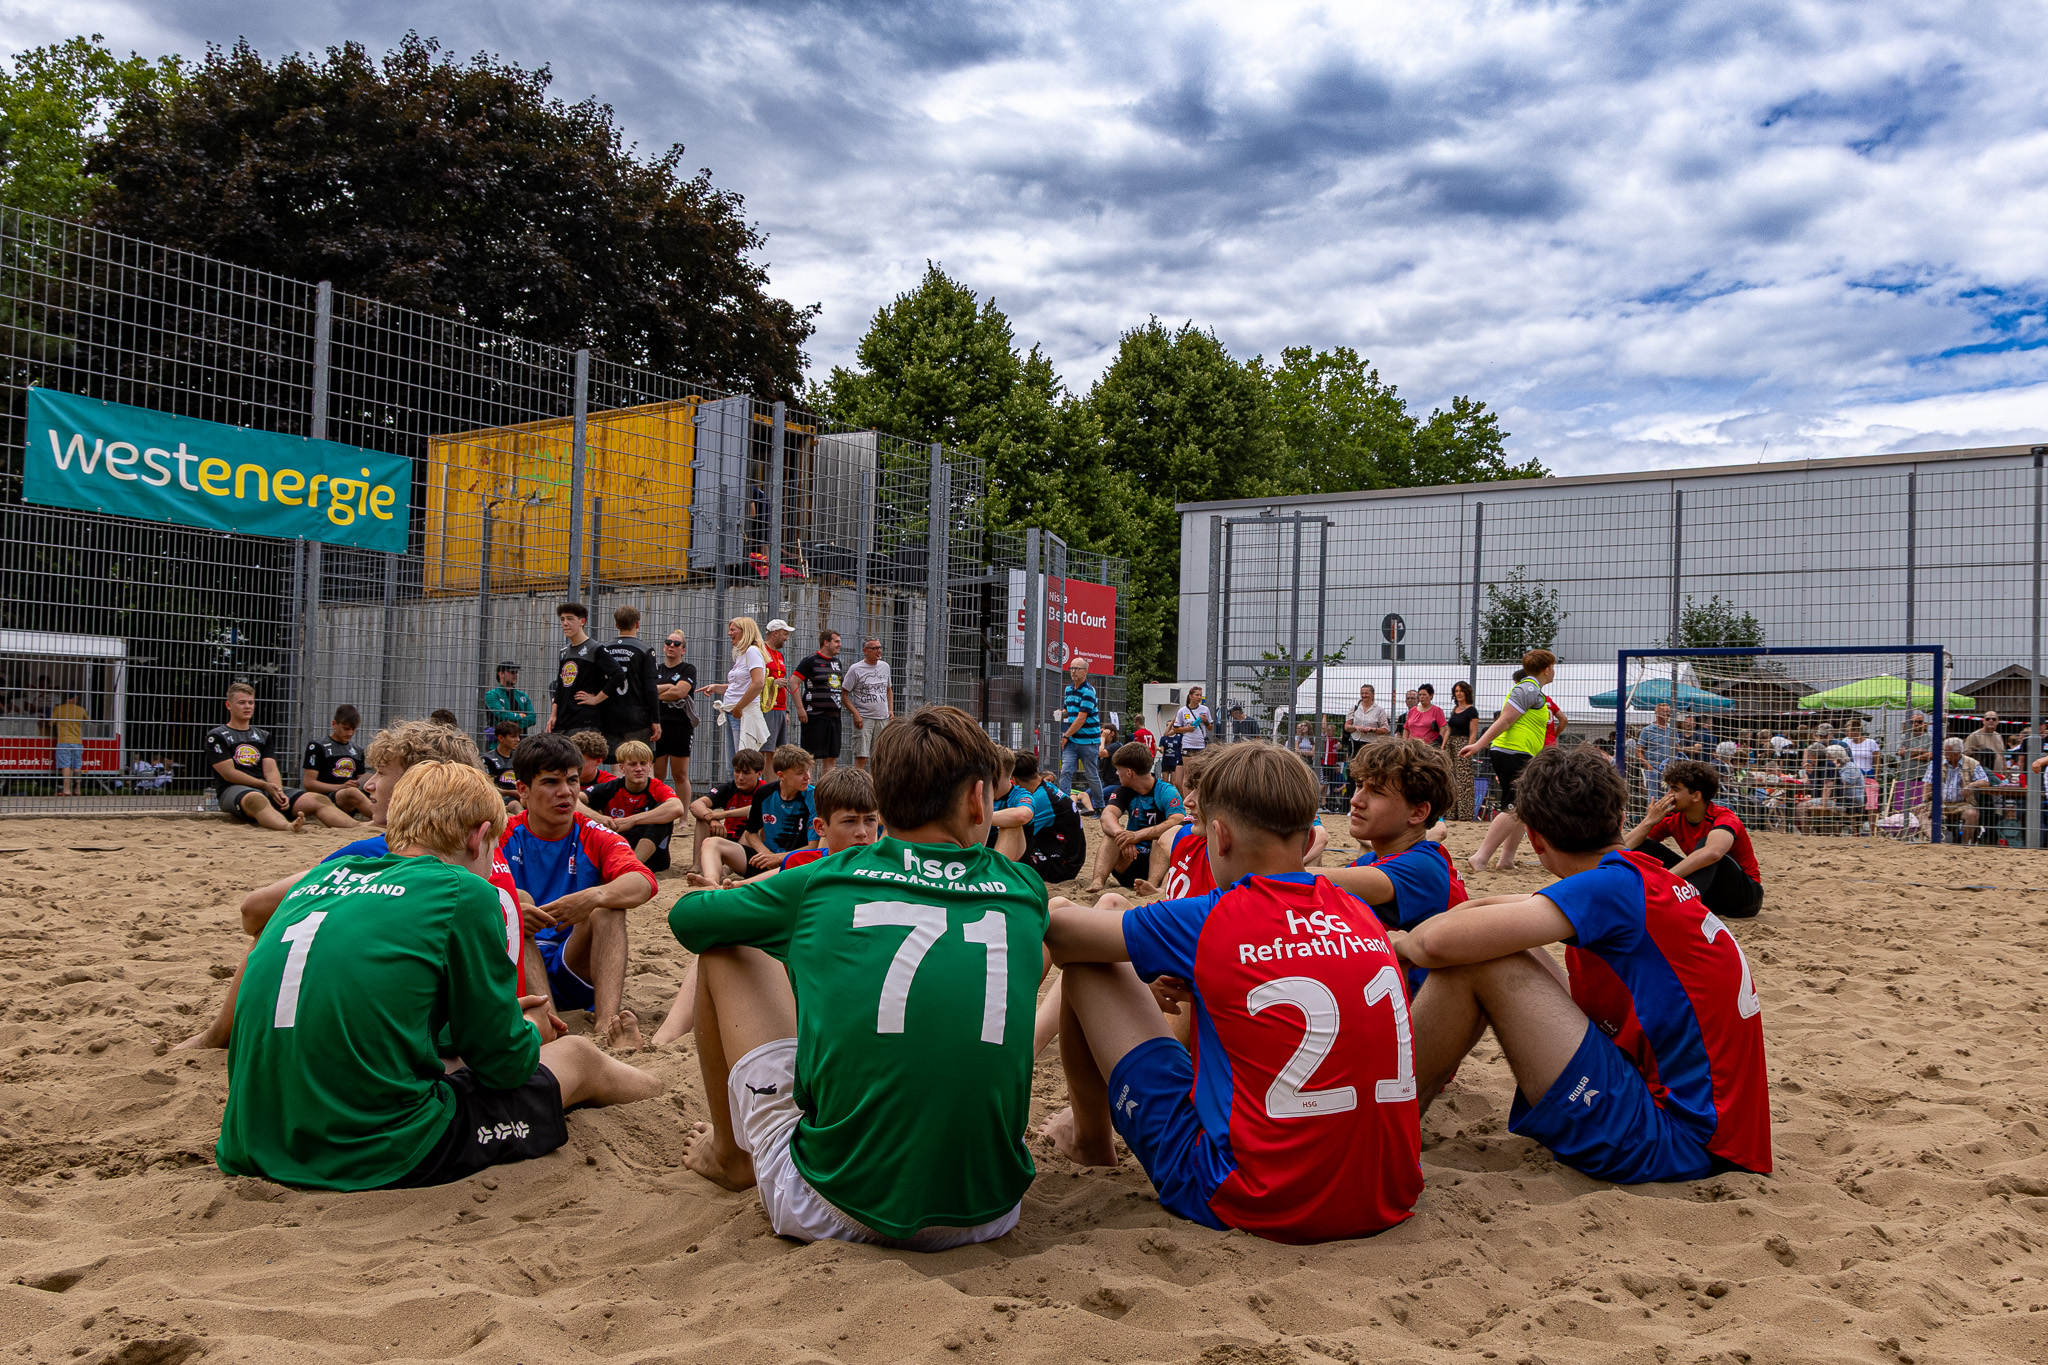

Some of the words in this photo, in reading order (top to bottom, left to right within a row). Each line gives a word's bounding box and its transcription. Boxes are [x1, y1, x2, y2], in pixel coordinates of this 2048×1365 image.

[48, 429, 396, 526] westenergie
[1049, 592, 1068, 604] Nisa
[1080, 611, 1107, 629] Court
[18, 758, 40, 766] stark
[82, 759, 101, 767] welt
[903, 848, 967, 881] HSG
[1285, 909, 1352, 936] HSG
[1238, 934, 1391, 965] Refrath/Hand
[273, 911, 328, 1028] 1
[853, 901, 1008, 1045] 71
[1246, 965, 1417, 1119] 21
[1115, 1084, 1130, 1111] erima
[1567, 1075, 1590, 1102] erima
[1302, 1100, 1318, 1108] HSG
